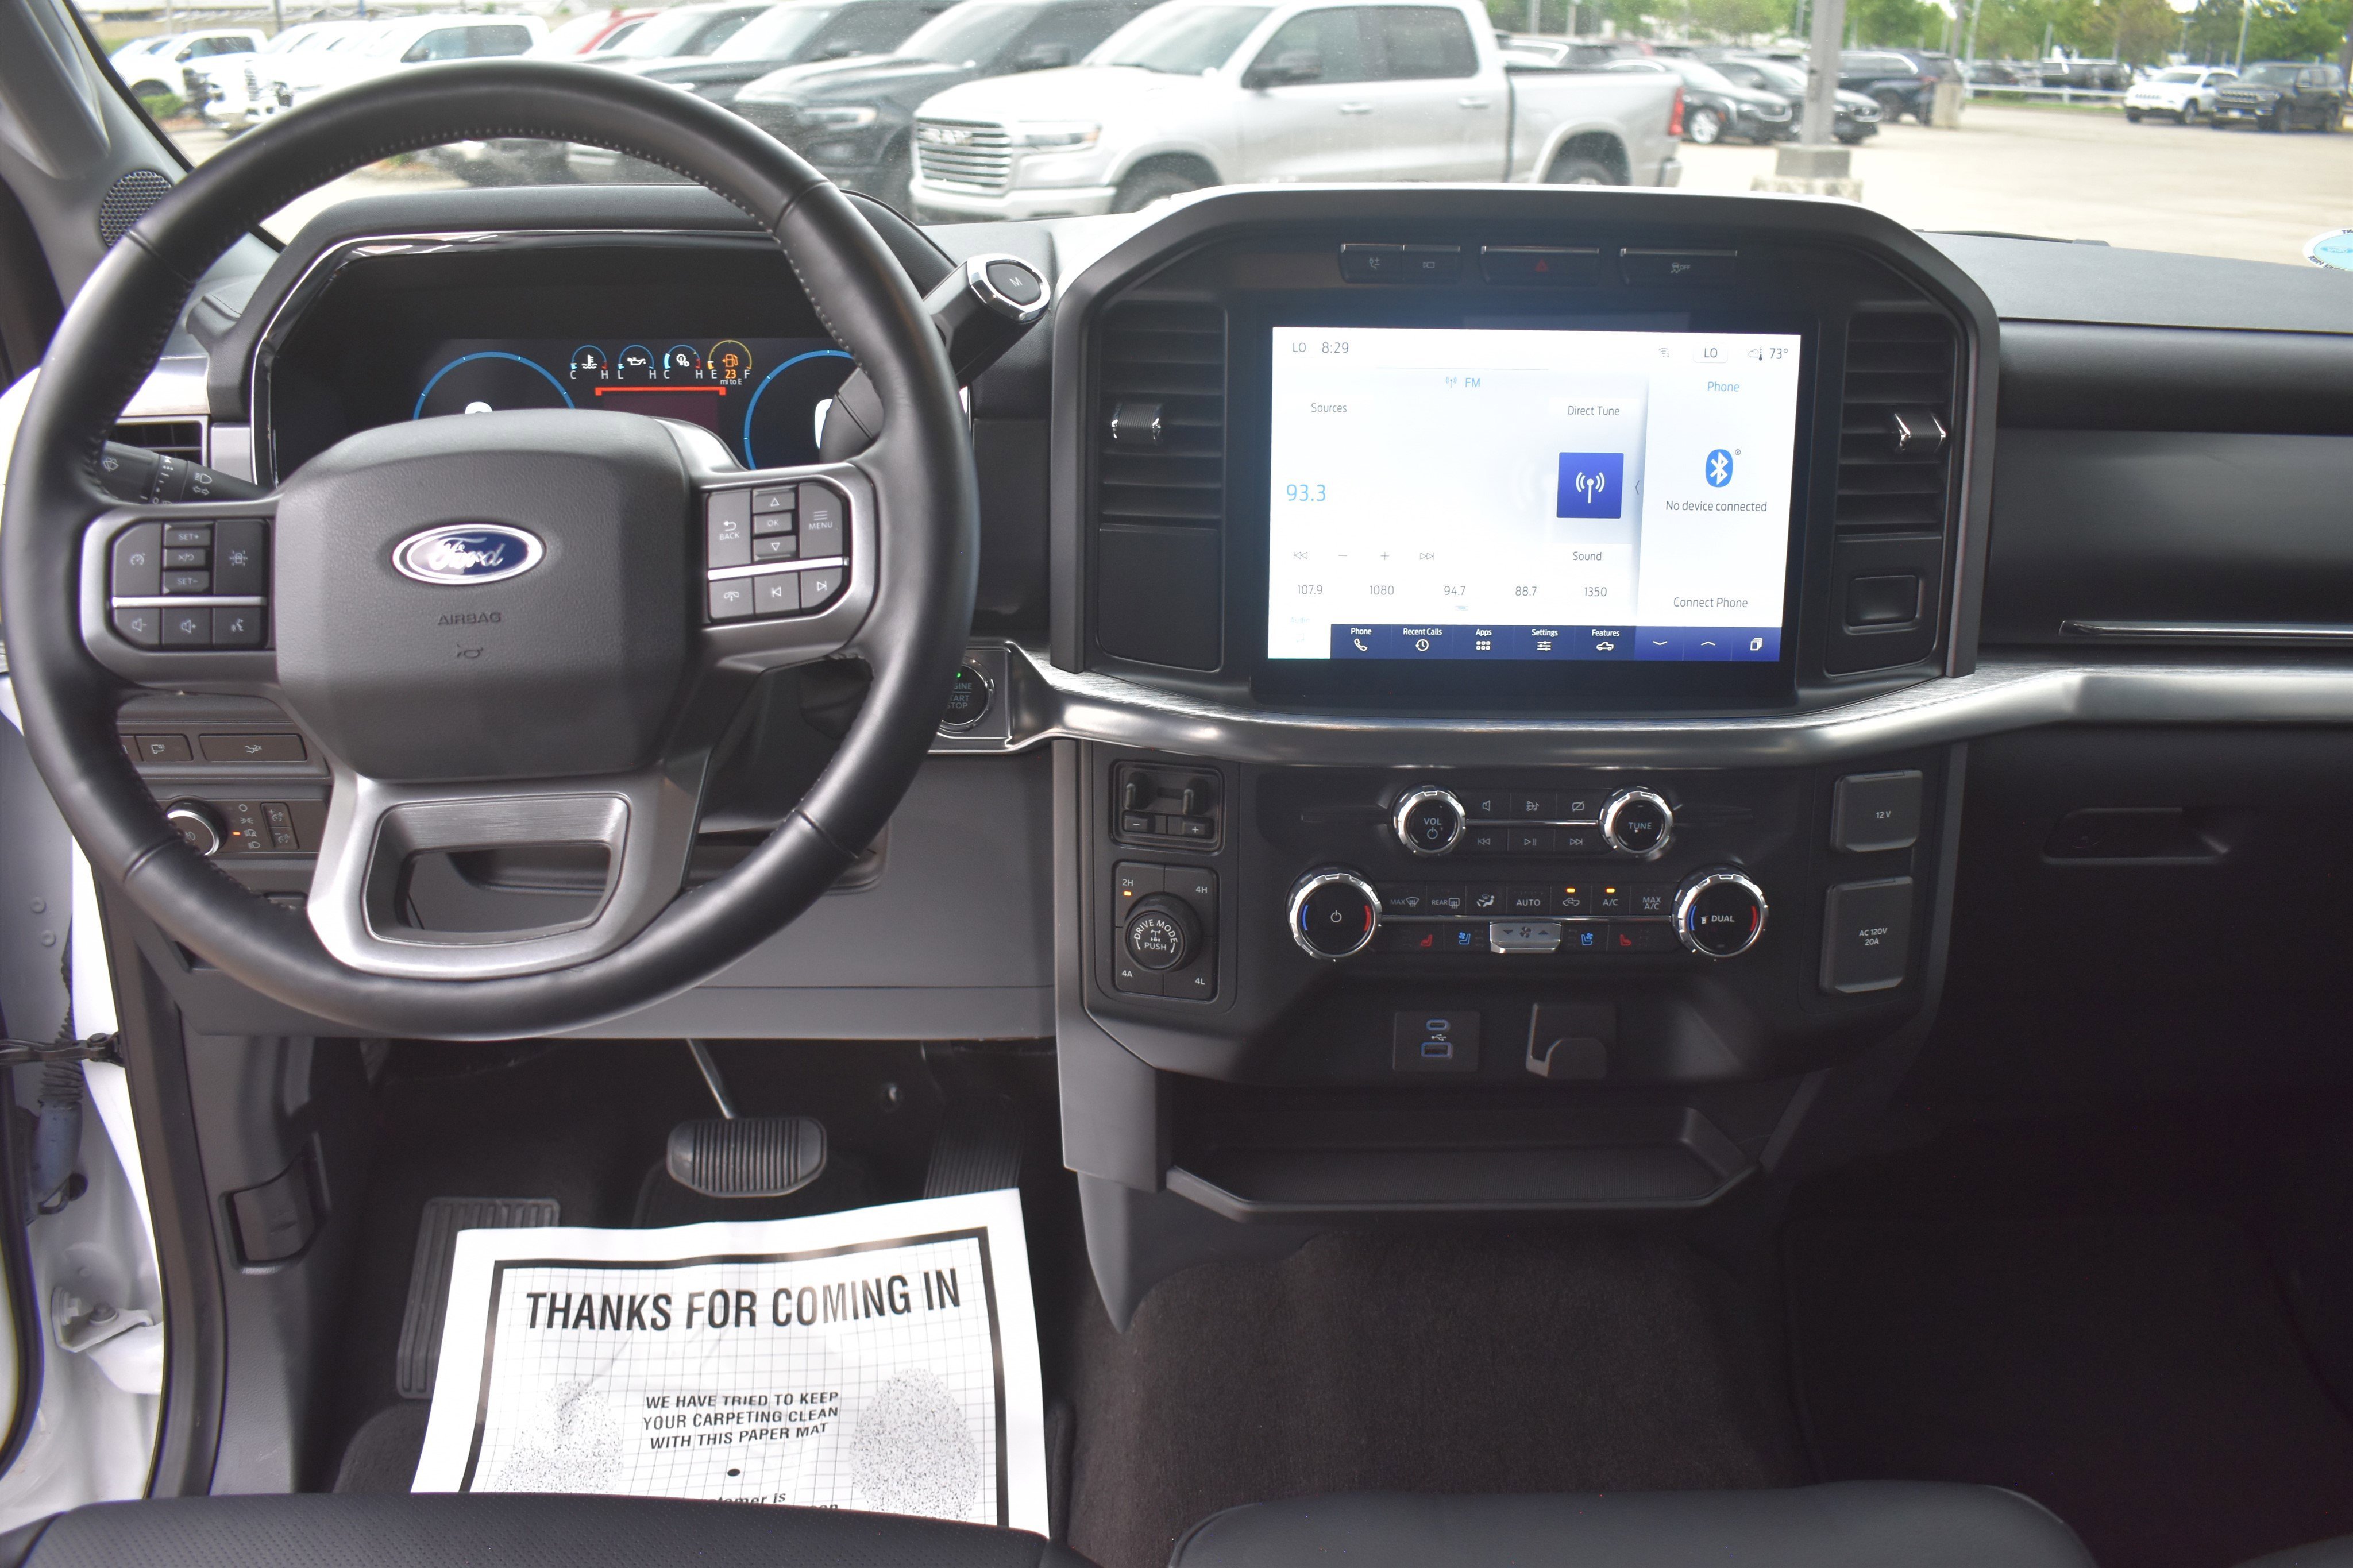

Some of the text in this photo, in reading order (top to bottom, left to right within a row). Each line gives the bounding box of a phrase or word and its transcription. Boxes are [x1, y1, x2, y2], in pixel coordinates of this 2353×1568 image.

[1009, 277, 1023, 287] M
[1292, 342, 1306, 353] LO
[1321, 342, 1349, 354] 8:29
[1704, 347, 1718, 358] LO
[1769, 347, 1788, 360] 73°
[570, 370, 577, 379] C
[601, 370, 608, 379] H
[618, 370, 624, 379] L
[649, 370, 656, 379] H
[664, 370, 670, 379] C
[696, 370, 703, 379] H
[711, 370, 717, 379] E
[725, 369, 736, 379] 23
[744, 370, 750, 379] F
[1465, 377, 1480, 388] FM
[1707, 382, 1739, 392] Phone
[1311, 403, 1347, 413] Sources
[1568, 405, 1620, 416] Direct Tune
[1286, 484, 1326, 502] 93.3
[1665, 500, 1768, 512] No device connected
[809, 522, 833, 530] MENU
[719, 532, 740, 540] BACK
[429, 537, 506, 570] Ford
[1572, 551, 1602, 561] Sound
[1297, 585, 1322, 595] 107.9
[1370, 585, 1394, 595] 1080
[1444, 586, 1465, 596] 94.7
[1515, 586, 1537, 596] 88.7
[1584, 587, 1607, 597] 1350
[1673, 597, 1748, 608] Connect Phone
[438, 612, 502, 625] AIRBAG
[1351, 628, 1372, 636] Phone
[1426, 628, 1442, 636] Calls
[1476, 628, 1492, 637] Apps
[1532, 629, 1558, 638] Settings
[1591, 629, 1620, 637] Features
[1122, 879, 1133, 887] 2H
[1195, 886, 1207, 894] 4H
[1603, 898, 1618, 906] A/C
[1134, 919, 1178, 943] DRIVE MODE
[1858, 928, 1888, 937] AC 120V
[1144, 942, 1167, 951] PUSH
[1865, 937, 1880, 946] 20A
[1121, 970, 1133, 978] 4A
[526, 1268, 961, 1331] THANKS FOR COMING IN
[646, 1392, 839, 1409] WE HAVE TRIED TO KEEP
[643, 1407, 839, 1430] YOUR CARPETING CLEAN
[650, 1423, 828, 1450] WITH THIS PAPER MAT
[773, 1493, 786, 1504] is
